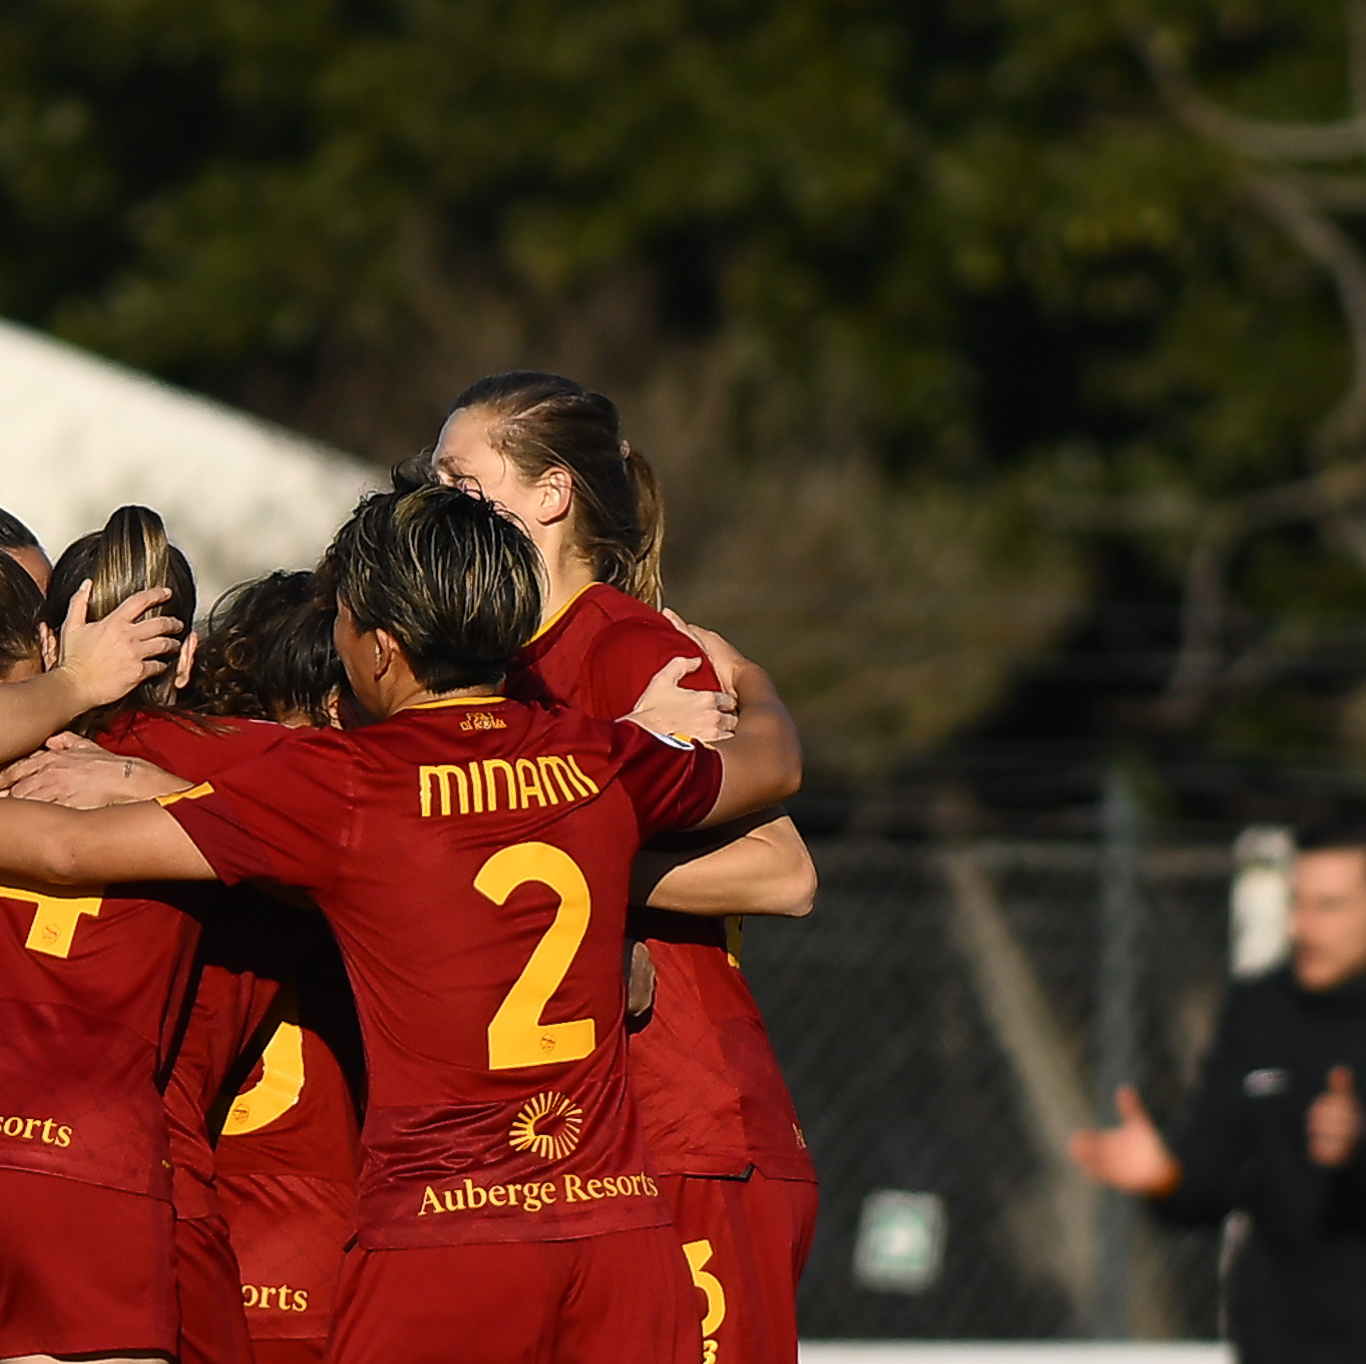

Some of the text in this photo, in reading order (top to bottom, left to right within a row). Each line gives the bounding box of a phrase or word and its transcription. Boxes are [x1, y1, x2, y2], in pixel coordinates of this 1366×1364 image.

[419, 754, 600, 818] MINAMI
[473, 841, 596, 1070] 2
[417, 1171, 659, 1216] Auberge Resorts
[242, 1284, 308, 1312] orts
